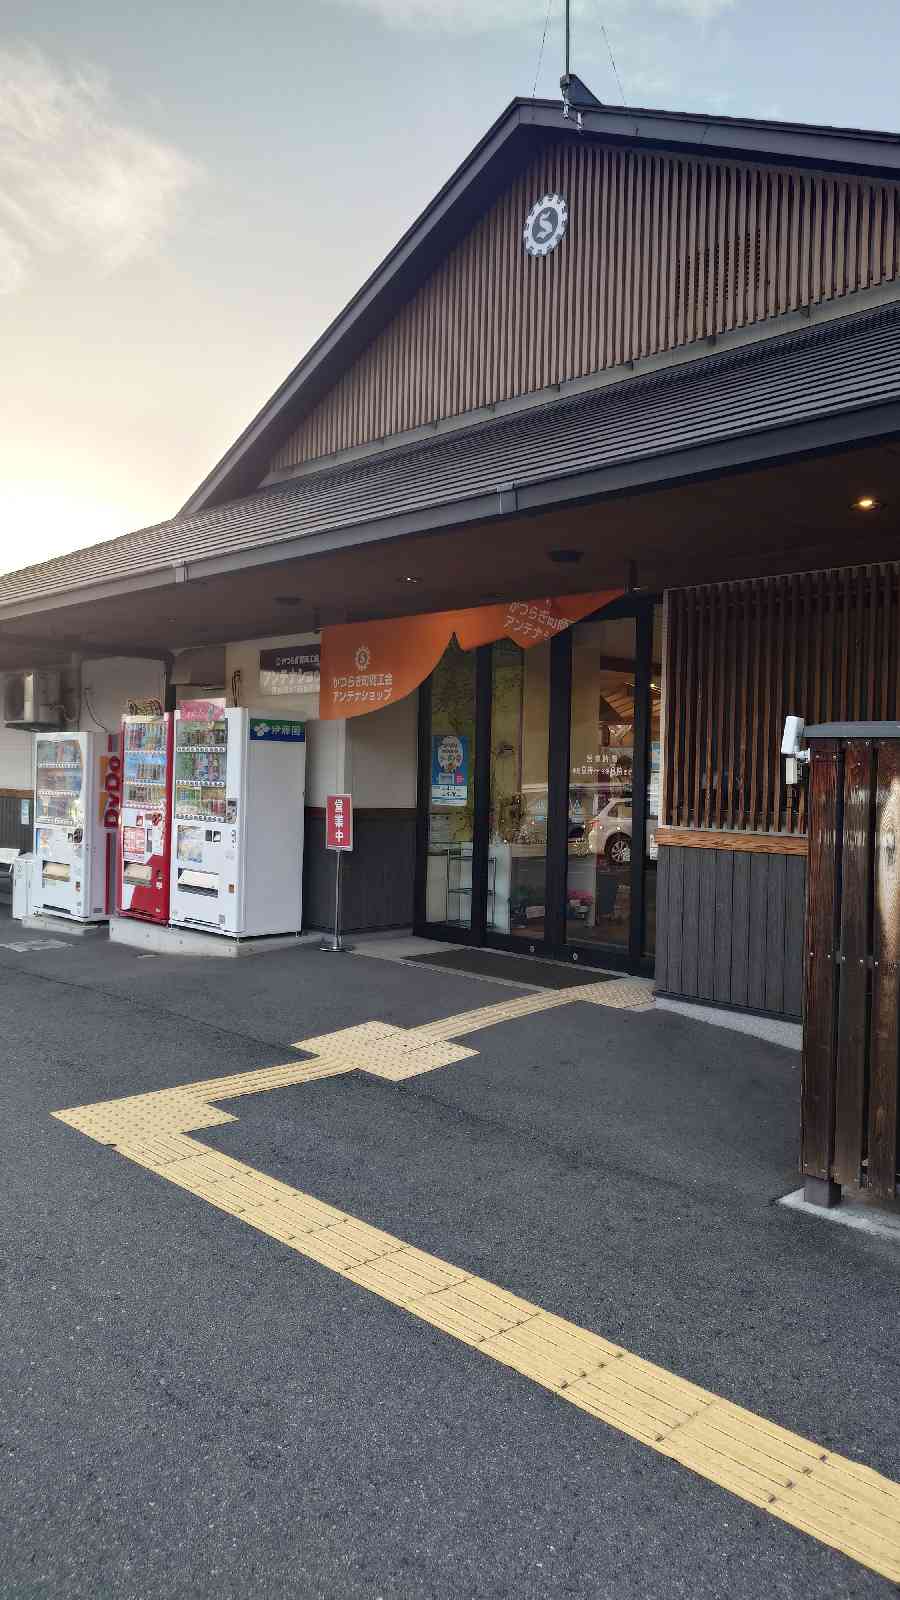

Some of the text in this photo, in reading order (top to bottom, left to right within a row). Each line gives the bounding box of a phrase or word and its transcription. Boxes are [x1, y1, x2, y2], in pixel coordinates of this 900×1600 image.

[331, 688, 393, 704] アンテナショップ
[104, 755, 121, 828] DyDo
[334, 799, 345, 843] 営業中
